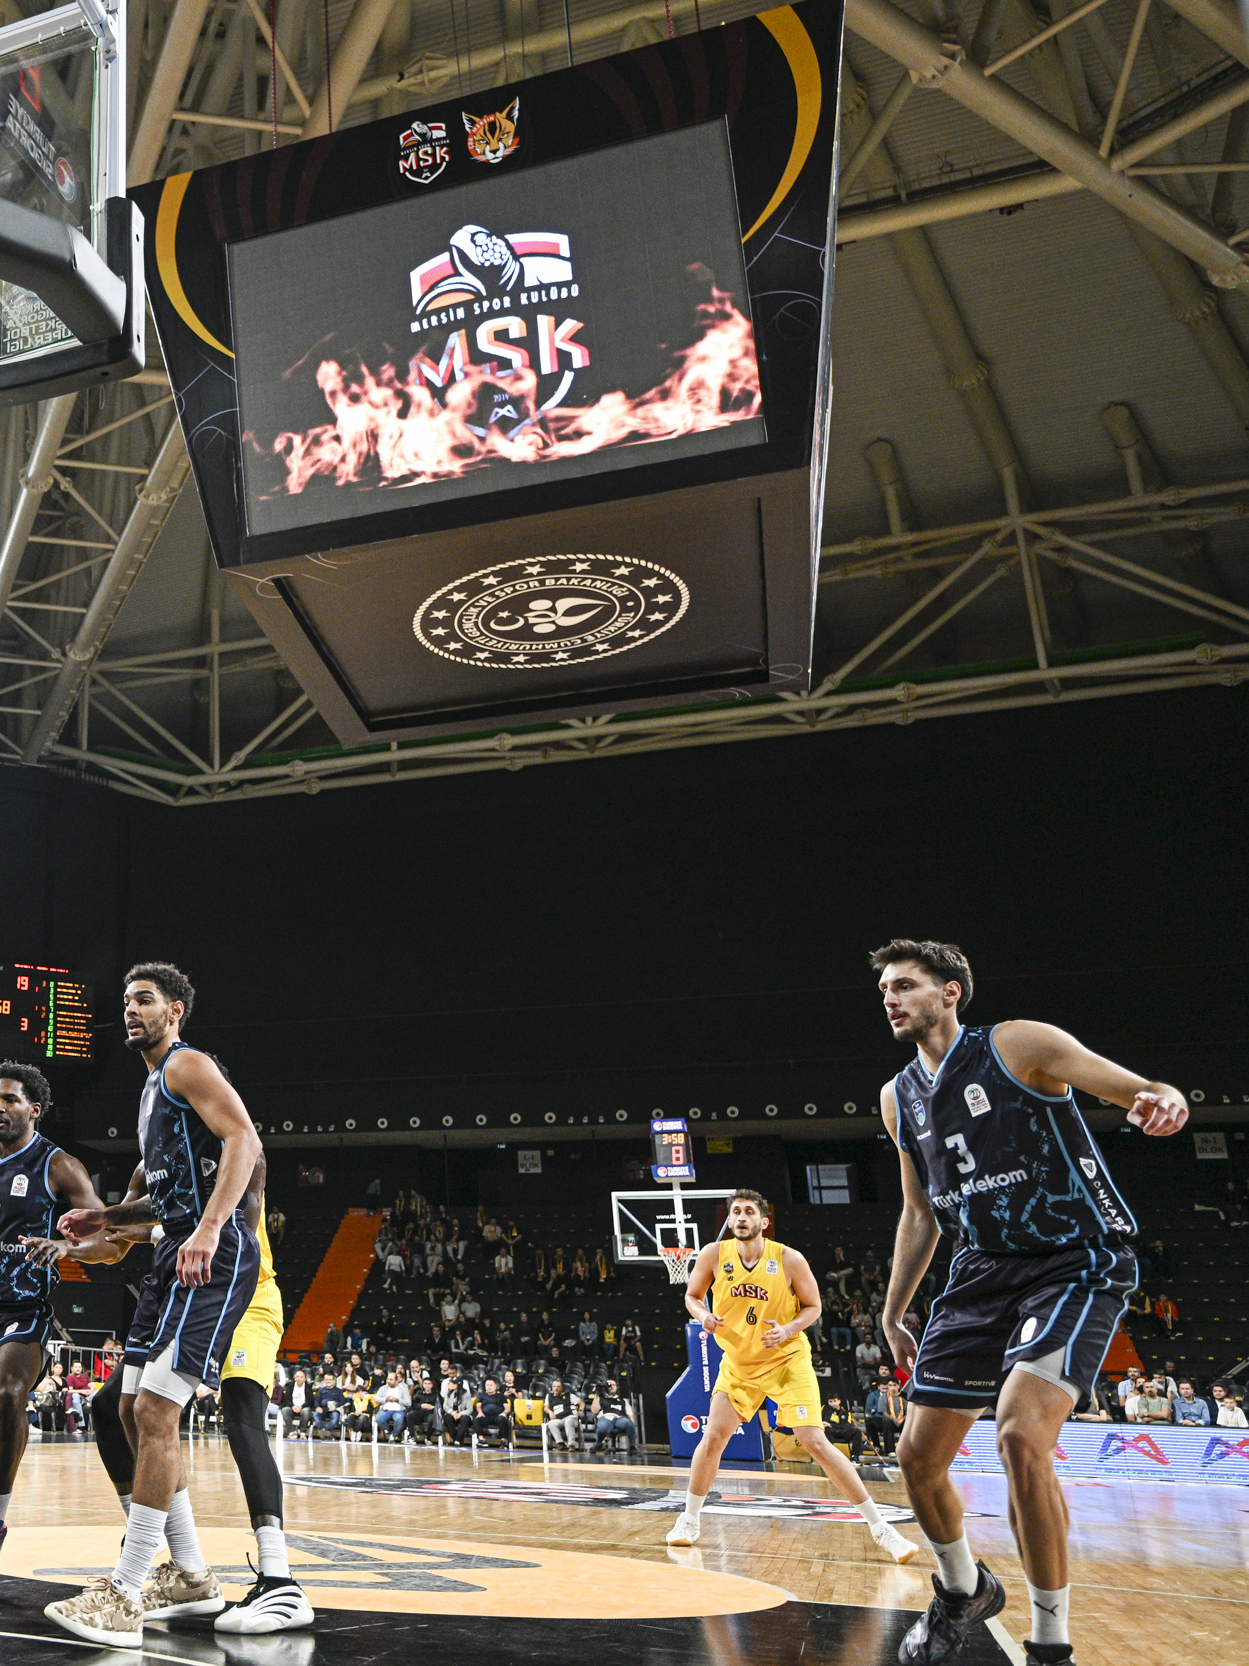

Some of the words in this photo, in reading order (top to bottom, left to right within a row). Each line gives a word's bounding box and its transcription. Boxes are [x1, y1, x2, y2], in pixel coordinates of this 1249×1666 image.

[399, 146, 451, 174] MSK
[410, 307, 466, 333] MERSİN
[473, 296, 511, 316] SPOR
[520, 283, 580, 306] KULÜBÜ
[409, 314, 591, 388] MSK
[497, 580, 541, 598] SPOR
[545, 578, 630, 598] BAKANLIĞI
[476, 594, 495, 609] VE
[587, 611, 635, 643] TÜRKİYE
[472, 632, 582, 651] CUMHURİYETİ
[17, 976, 29, 991] 19
[20, 1017, 29, 1031] 3
[662, 1133, 685, 1145] 3:58
[671, 1145, 684, 1165] 8
[944, 1133, 976, 1175] 3
[961, 1169, 1028, 1194] elekom
[731, 1283, 768, 1301] MSK
[746, 1306, 757, 1325] 6
